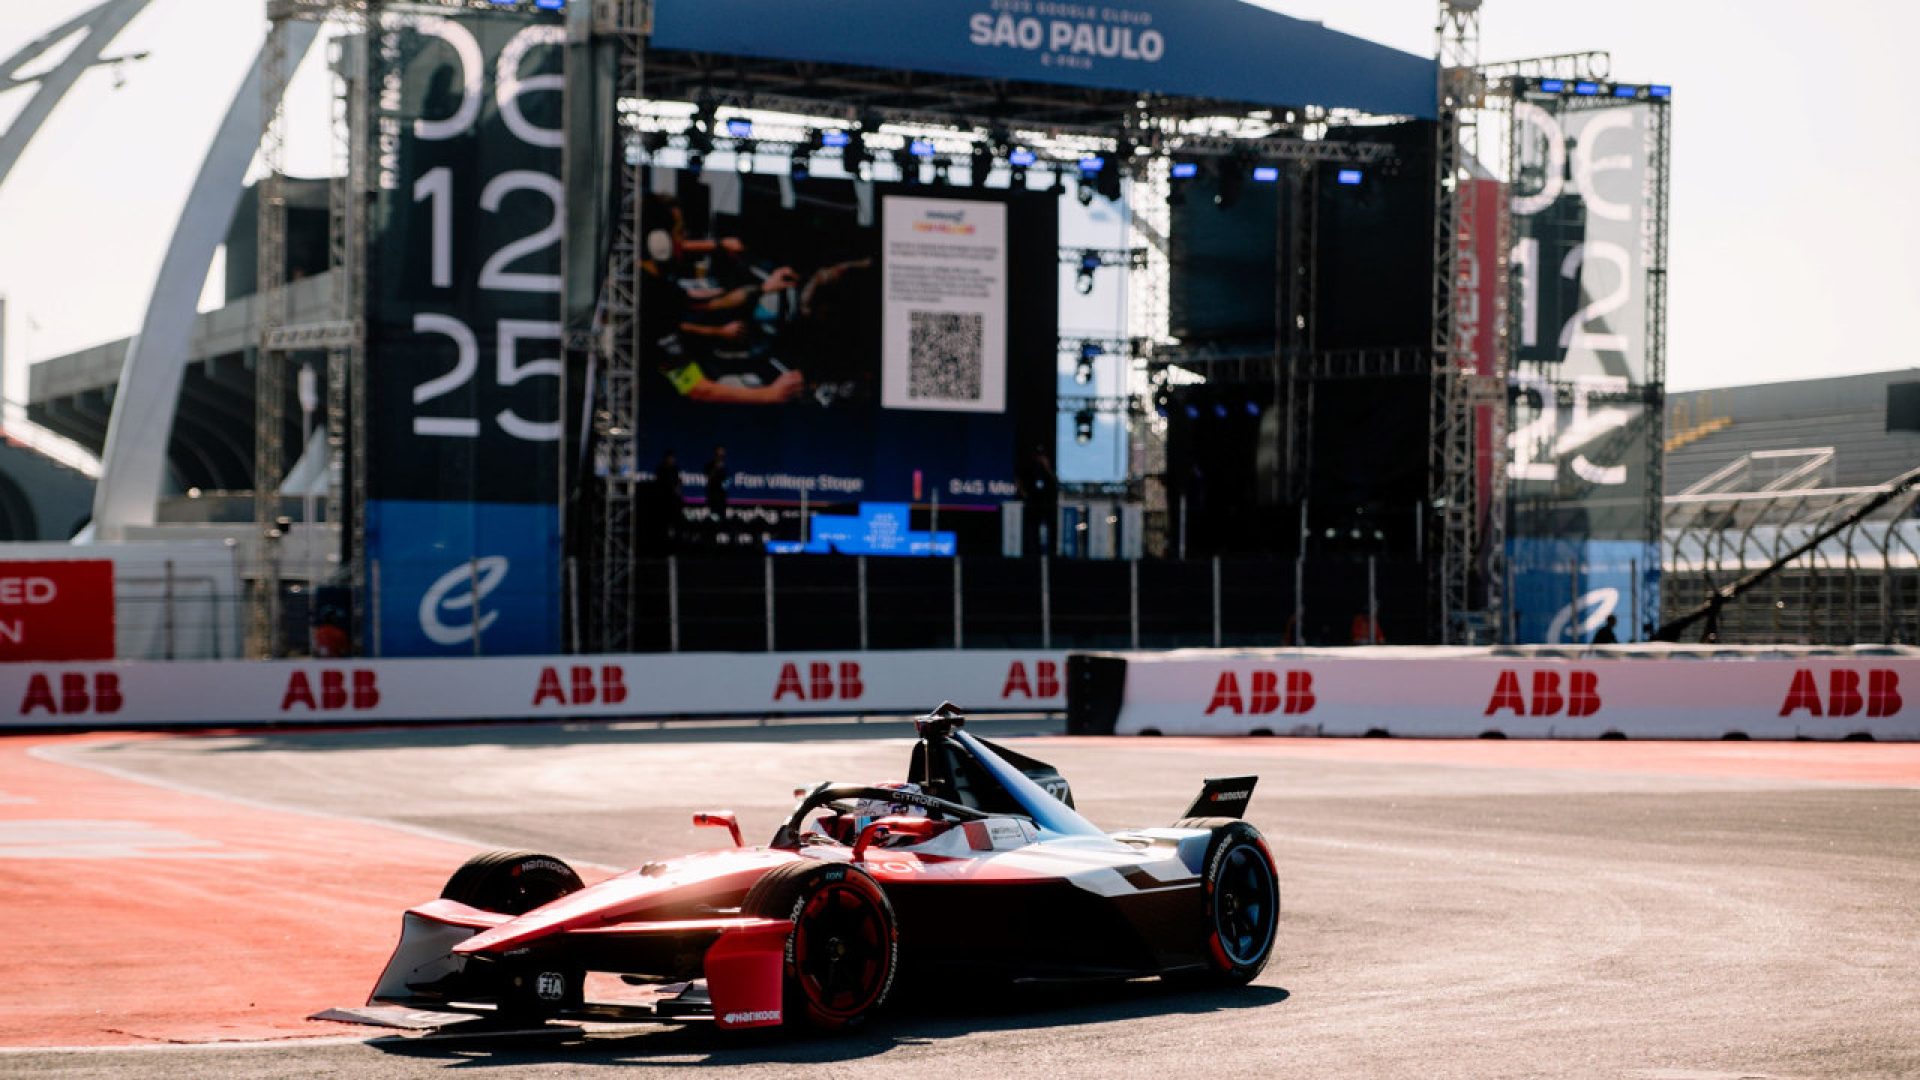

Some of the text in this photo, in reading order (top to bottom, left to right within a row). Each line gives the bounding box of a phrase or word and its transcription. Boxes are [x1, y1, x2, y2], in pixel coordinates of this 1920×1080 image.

[969, 12, 1164, 61] SÃO PAULO
[413, 167, 562, 289] 12
[1510, 237, 1631, 349] 12
[412, 312, 562, 441] 25
[20, 672, 123, 715] ABB
[281, 669, 380, 711] ABB
[533, 665, 627, 705] ABB
[773, 661, 864, 700] ABB
[1002, 660, 1067, 699] AB
[1204, 670, 1316, 715] ABB
[1484, 669, 1601, 717] ABB
[1779, 669, 1902, 717] ABB
[539, 977, 562, 996] FIA
